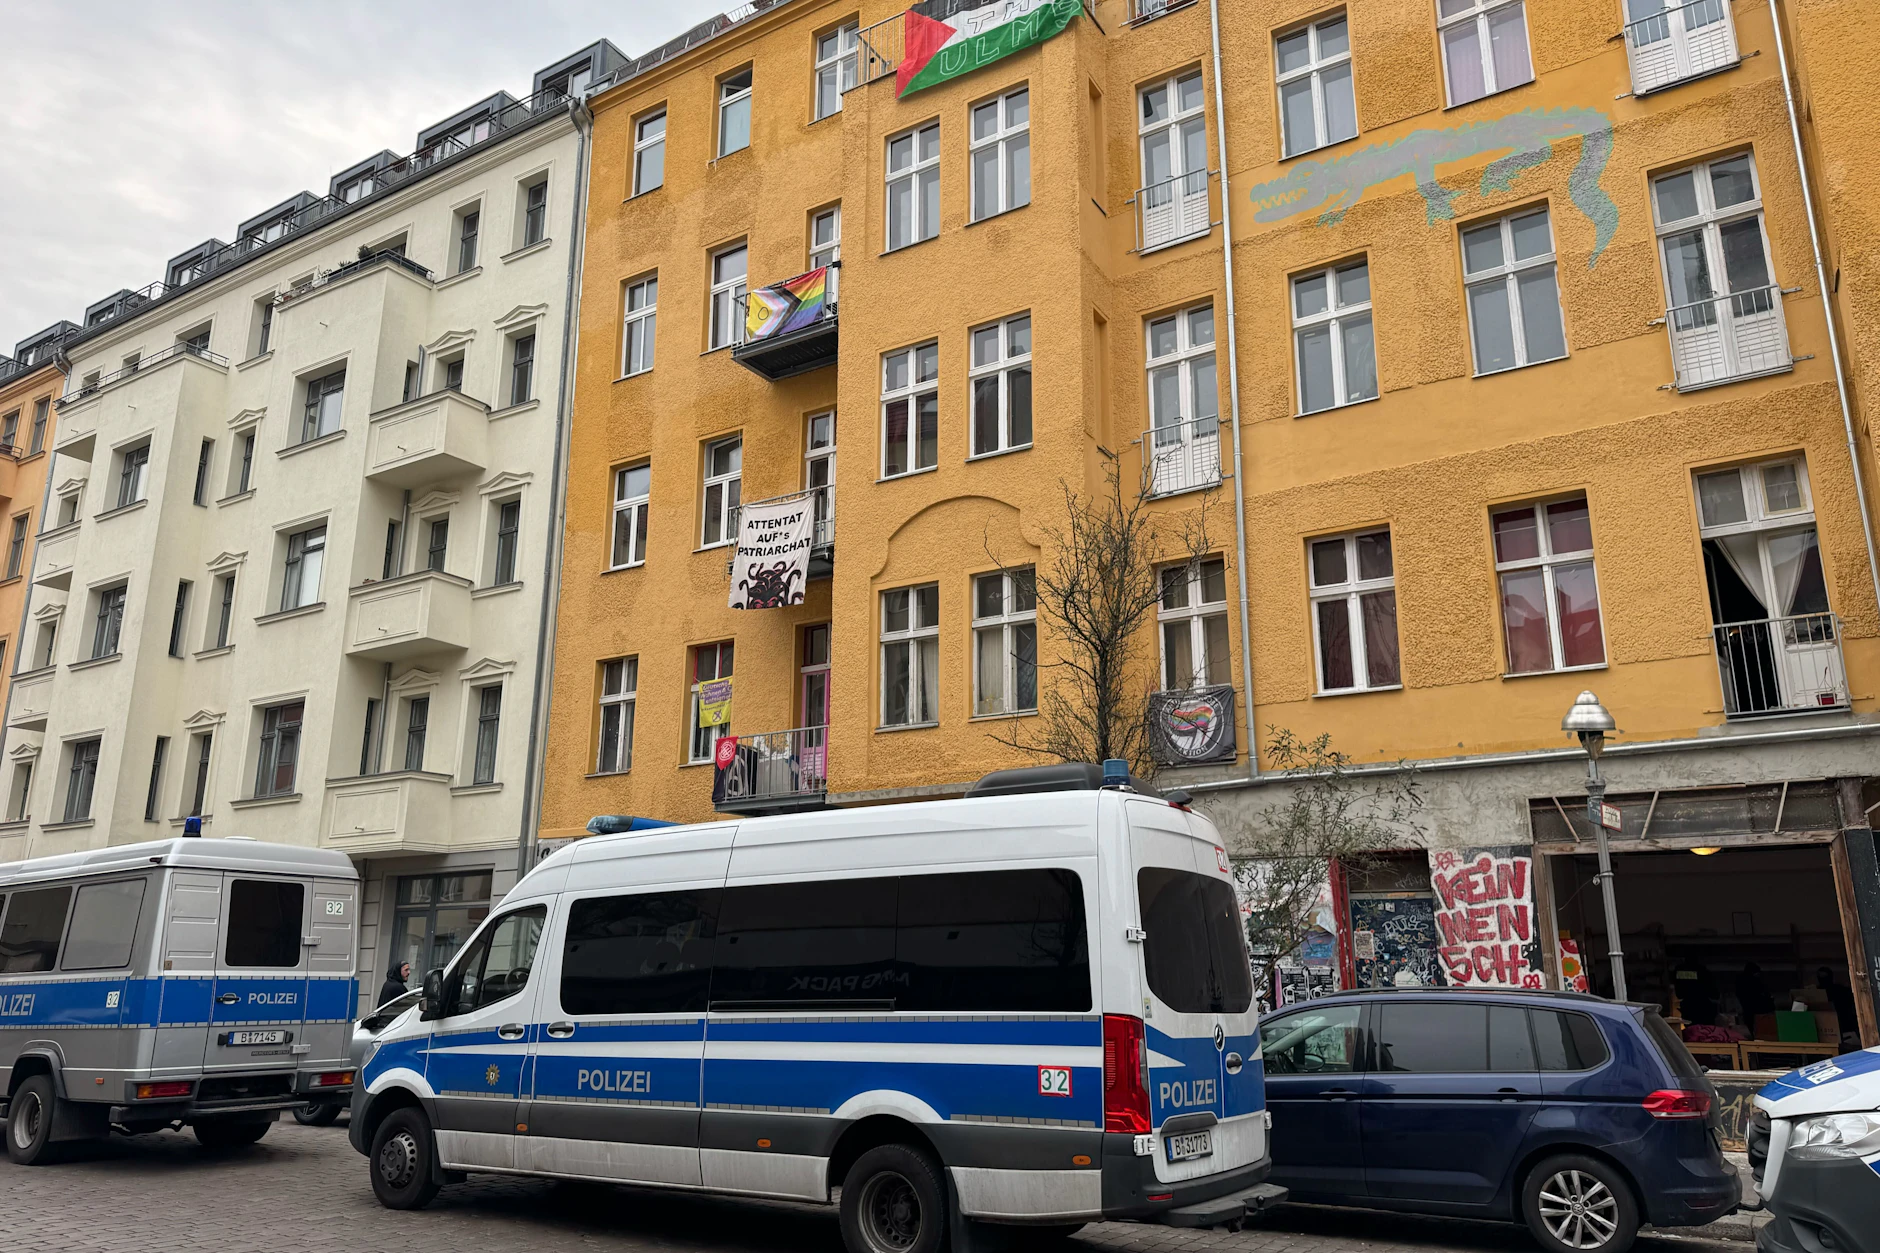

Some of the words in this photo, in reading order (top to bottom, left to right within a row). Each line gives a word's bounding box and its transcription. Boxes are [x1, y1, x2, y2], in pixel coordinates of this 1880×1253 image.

[747, 512, 803, 530] ATTENTAT
[737, 538, 811, 557] PATRIARCHAT
[327, 902, 342, 914] 32
[1437, 904, 1530, 946] MEN
[107, 993, 119, 1006] 32
[247, 992, 298, 1005] POLIZEI
[577, 1069, 651, 1093] POLIZEI
[1041, 1069, 1068, 1092] 32
[1159, 1079, 1217, 1109] POLIZEI
